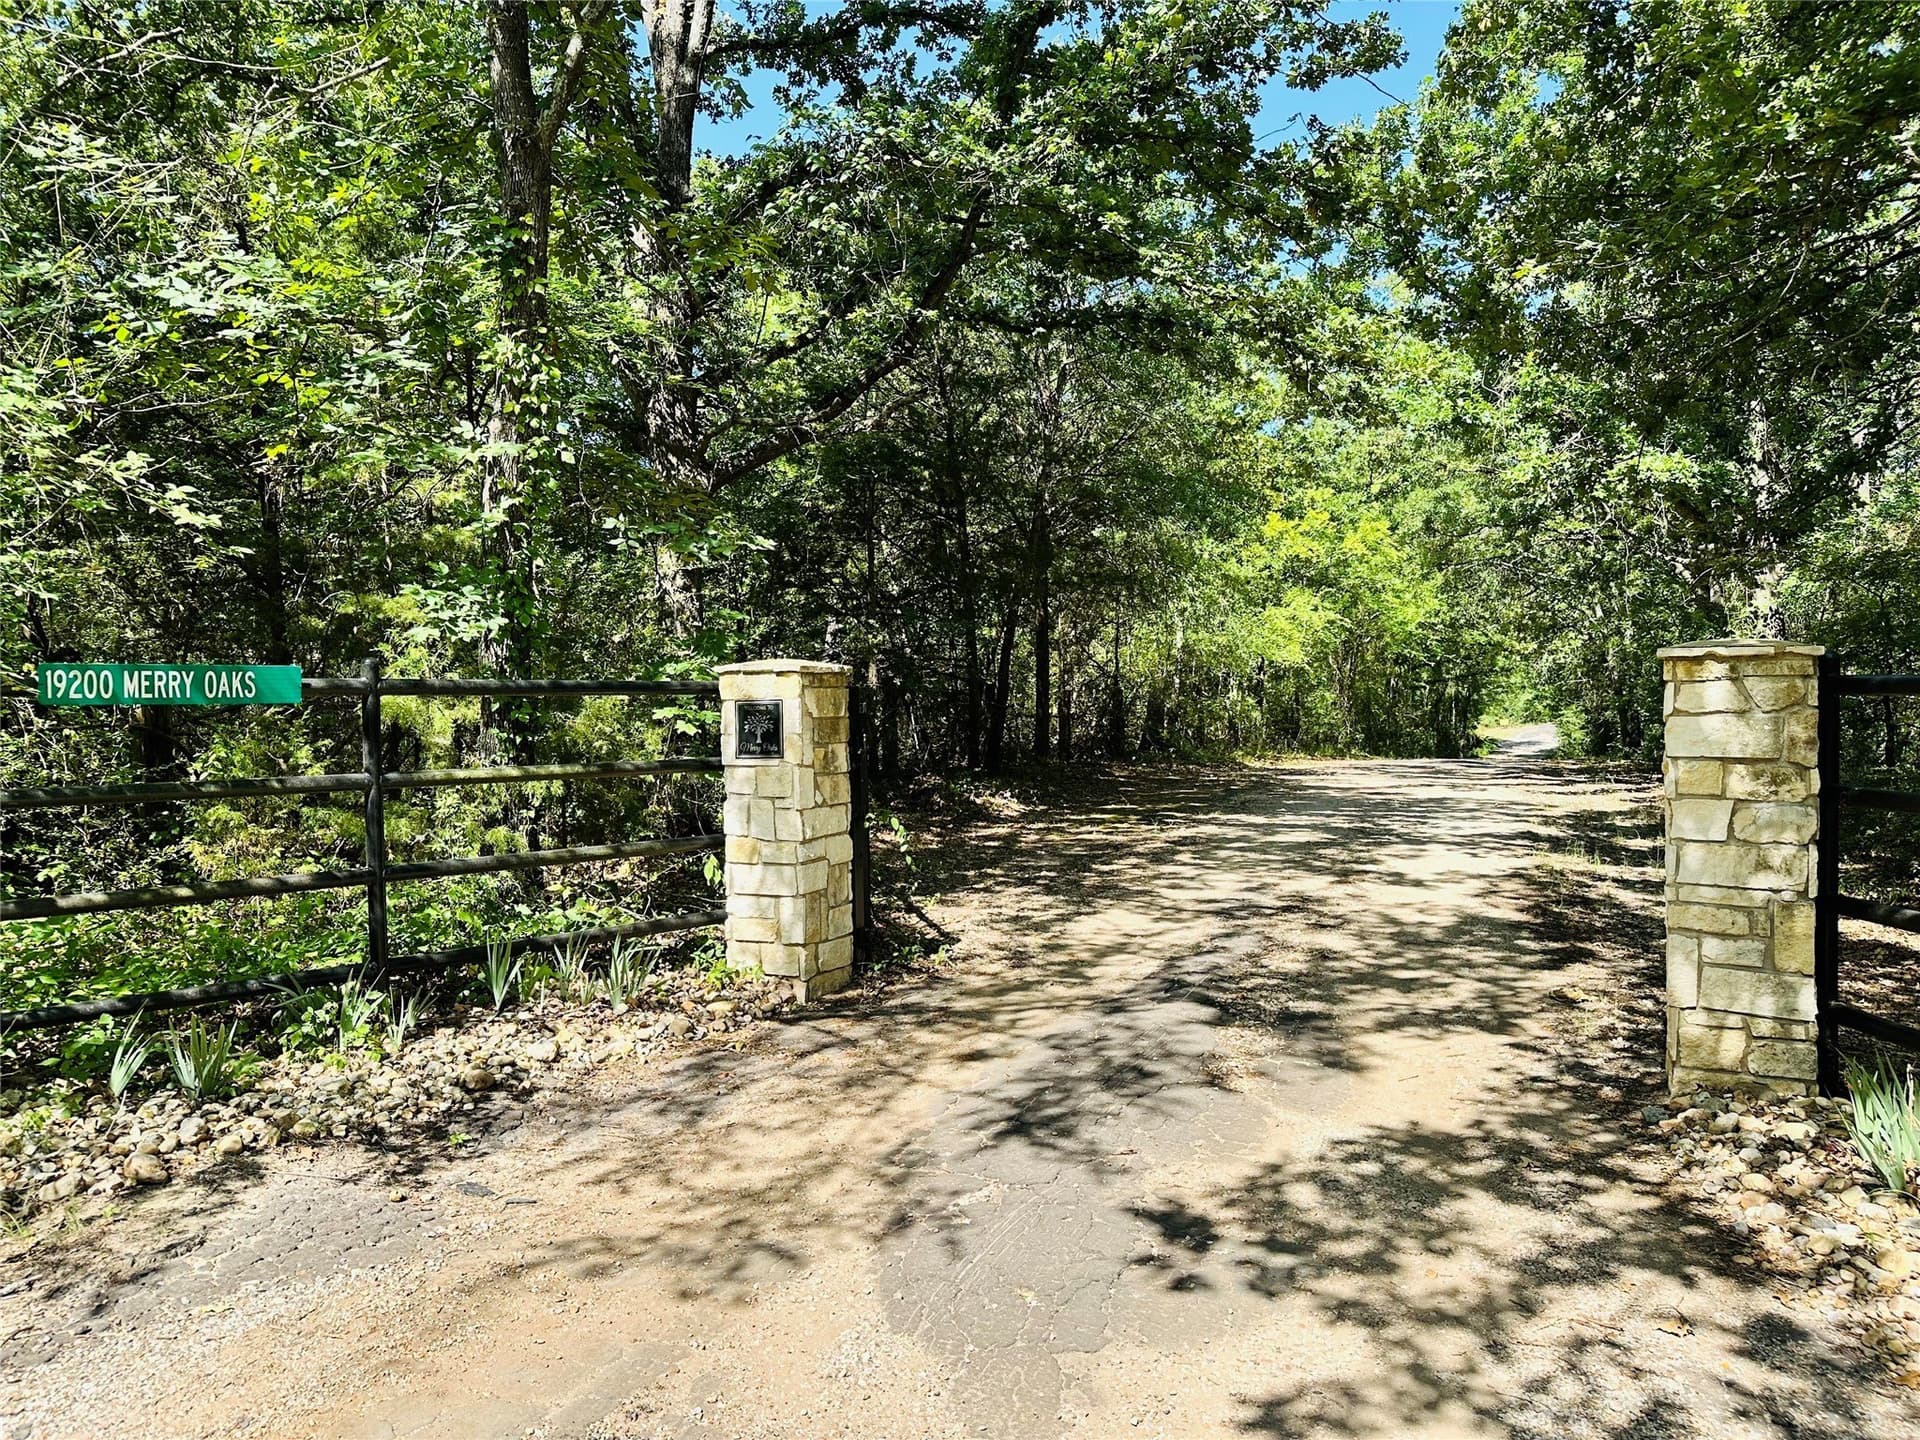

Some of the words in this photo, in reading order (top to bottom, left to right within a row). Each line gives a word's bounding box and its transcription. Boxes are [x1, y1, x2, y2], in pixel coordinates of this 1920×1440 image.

[46, 670, 113, 699] 19200
[123, 670, 195, 699] MERRY
[204, 670, 256, 699] OAKS
